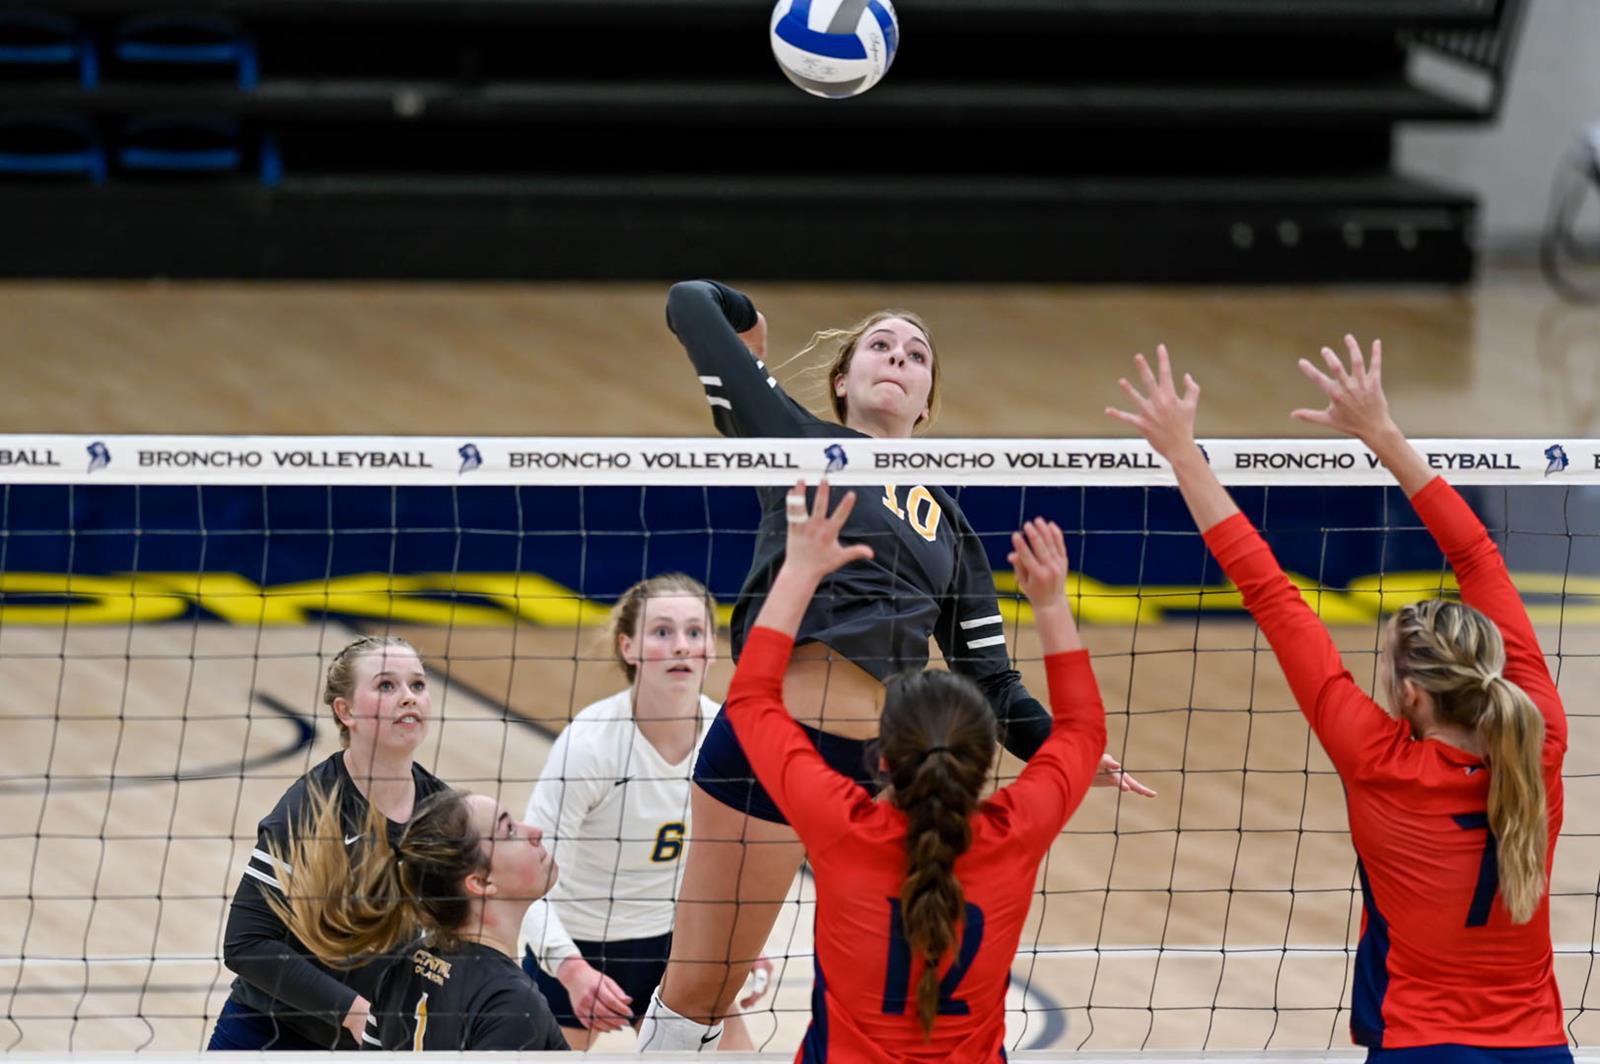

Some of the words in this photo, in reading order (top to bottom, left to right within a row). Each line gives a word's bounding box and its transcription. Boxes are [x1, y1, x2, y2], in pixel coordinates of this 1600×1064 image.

[138, 451, 263, 467] BRONCHO
[273, 451, 433, 468] VOLLEYBALL
[509, 452, 631, 469] BRONCHO
[641, 452, 799, 469] VOLLEYBALL
[873, 452, 995, 469] BRONCHO
[1004, 452, 1161, 469] VOLLEYBALL
[1234, 452, 1356, 469] BRONCHO
[1363, 452, 1521, 470] VEYBALL
[882, 484, 942, 542] 10
[650, 822, 686, 863] 6
[1451, 812, 1501, 928] 7
[881, 896, 985, 1016] 12
[413, 992, 429, 1053] 1
